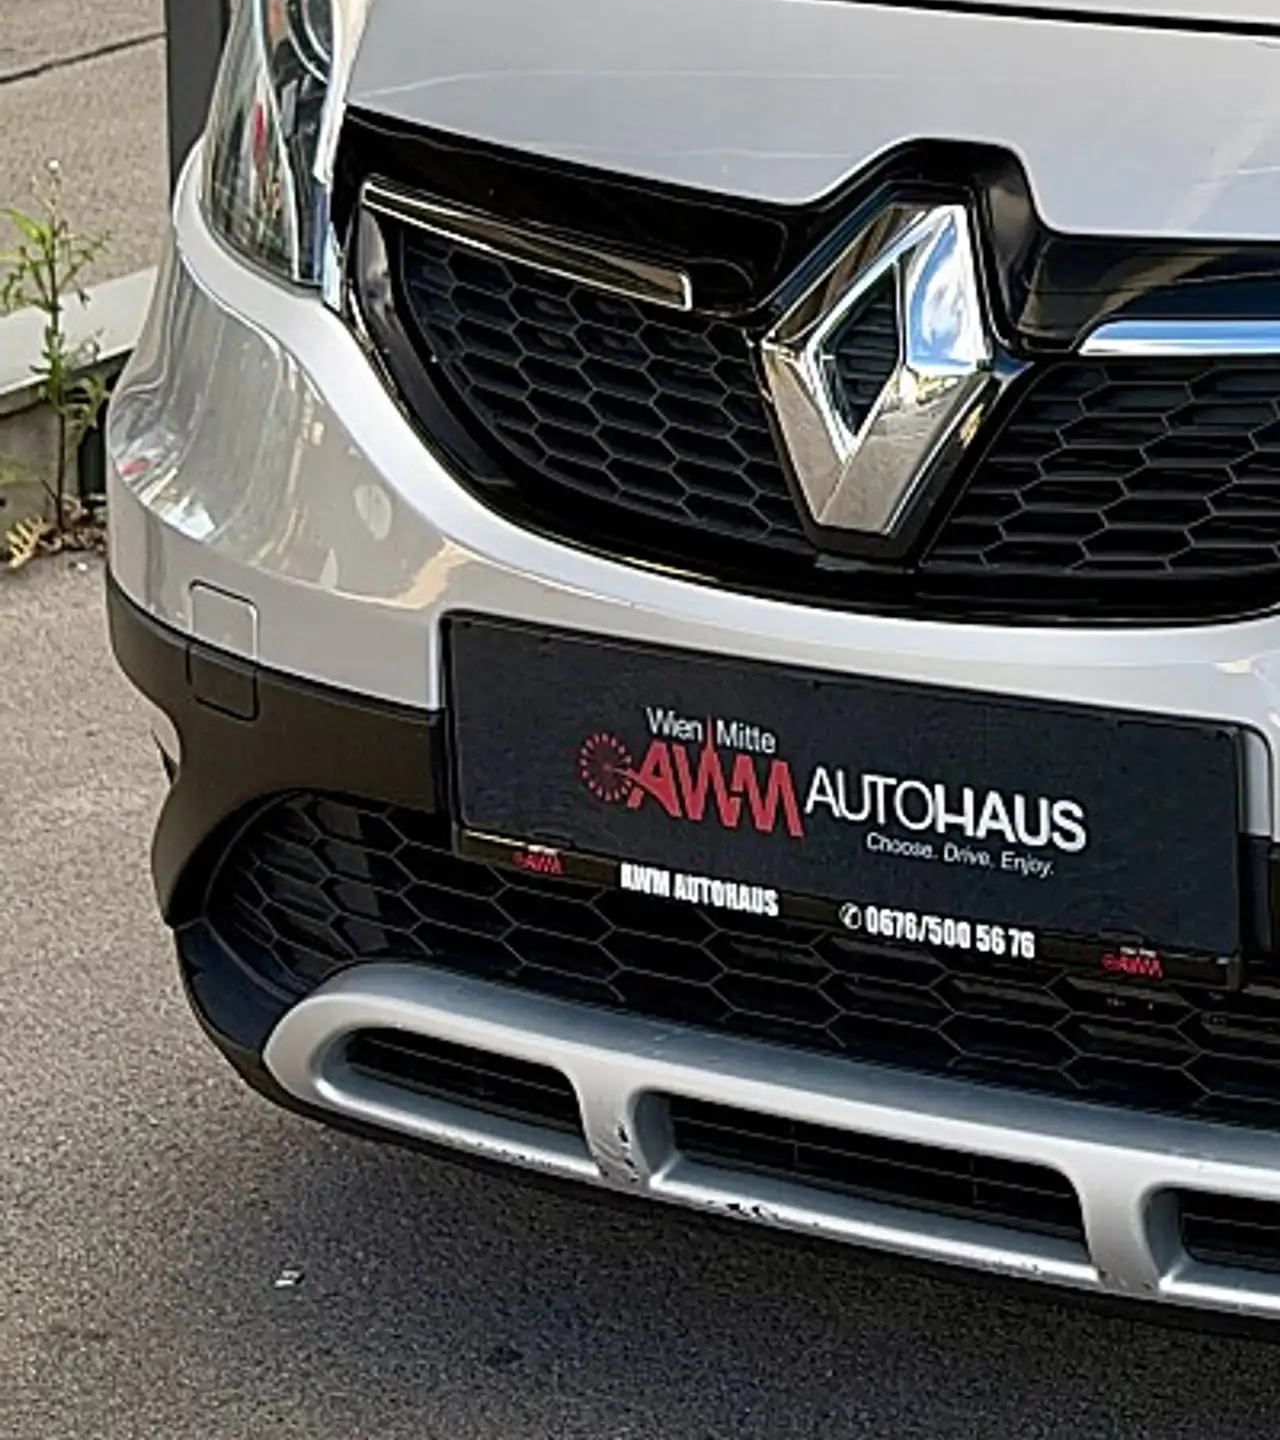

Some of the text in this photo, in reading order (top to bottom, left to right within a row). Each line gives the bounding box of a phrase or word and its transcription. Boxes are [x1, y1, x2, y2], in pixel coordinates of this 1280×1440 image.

[645, 706, 776, 754] Wien Mitte
[804, 765, 1087, 852] AUTOHAUS
[866, 831, 1054, 878] Choose. Drive. Enjoy.
[620, 862, 779, 917] AWM AUTOHAUS
[975, 928, 1006, 955] 56
[1008, 930, 1036, 959] 76
